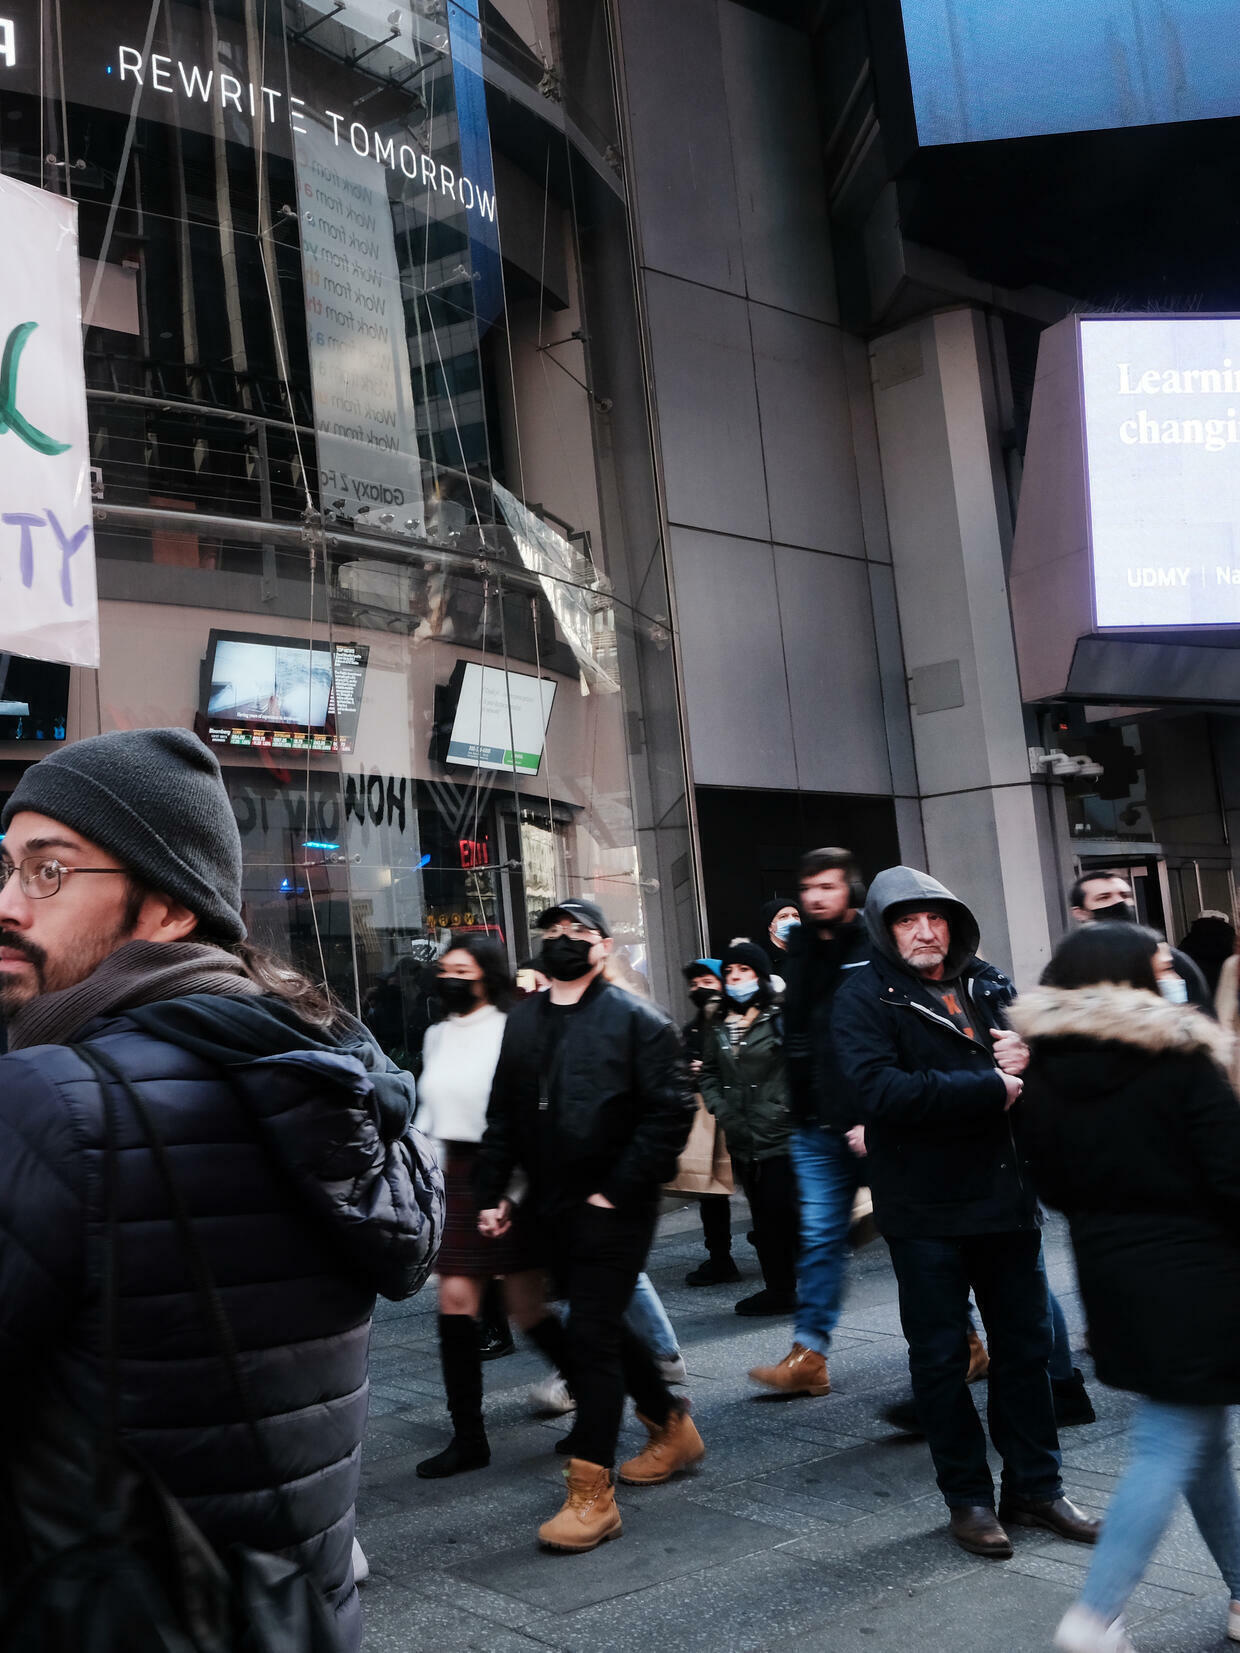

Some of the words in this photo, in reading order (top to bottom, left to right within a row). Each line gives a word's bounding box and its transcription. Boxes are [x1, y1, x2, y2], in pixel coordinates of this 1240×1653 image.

[118, 45, 308, 135] REWRITE
[325, 110, 496, 222] TOMORROW
[1119, 407, 1240, 452] changi
[1127, 567, 1191, 588] UDMY
